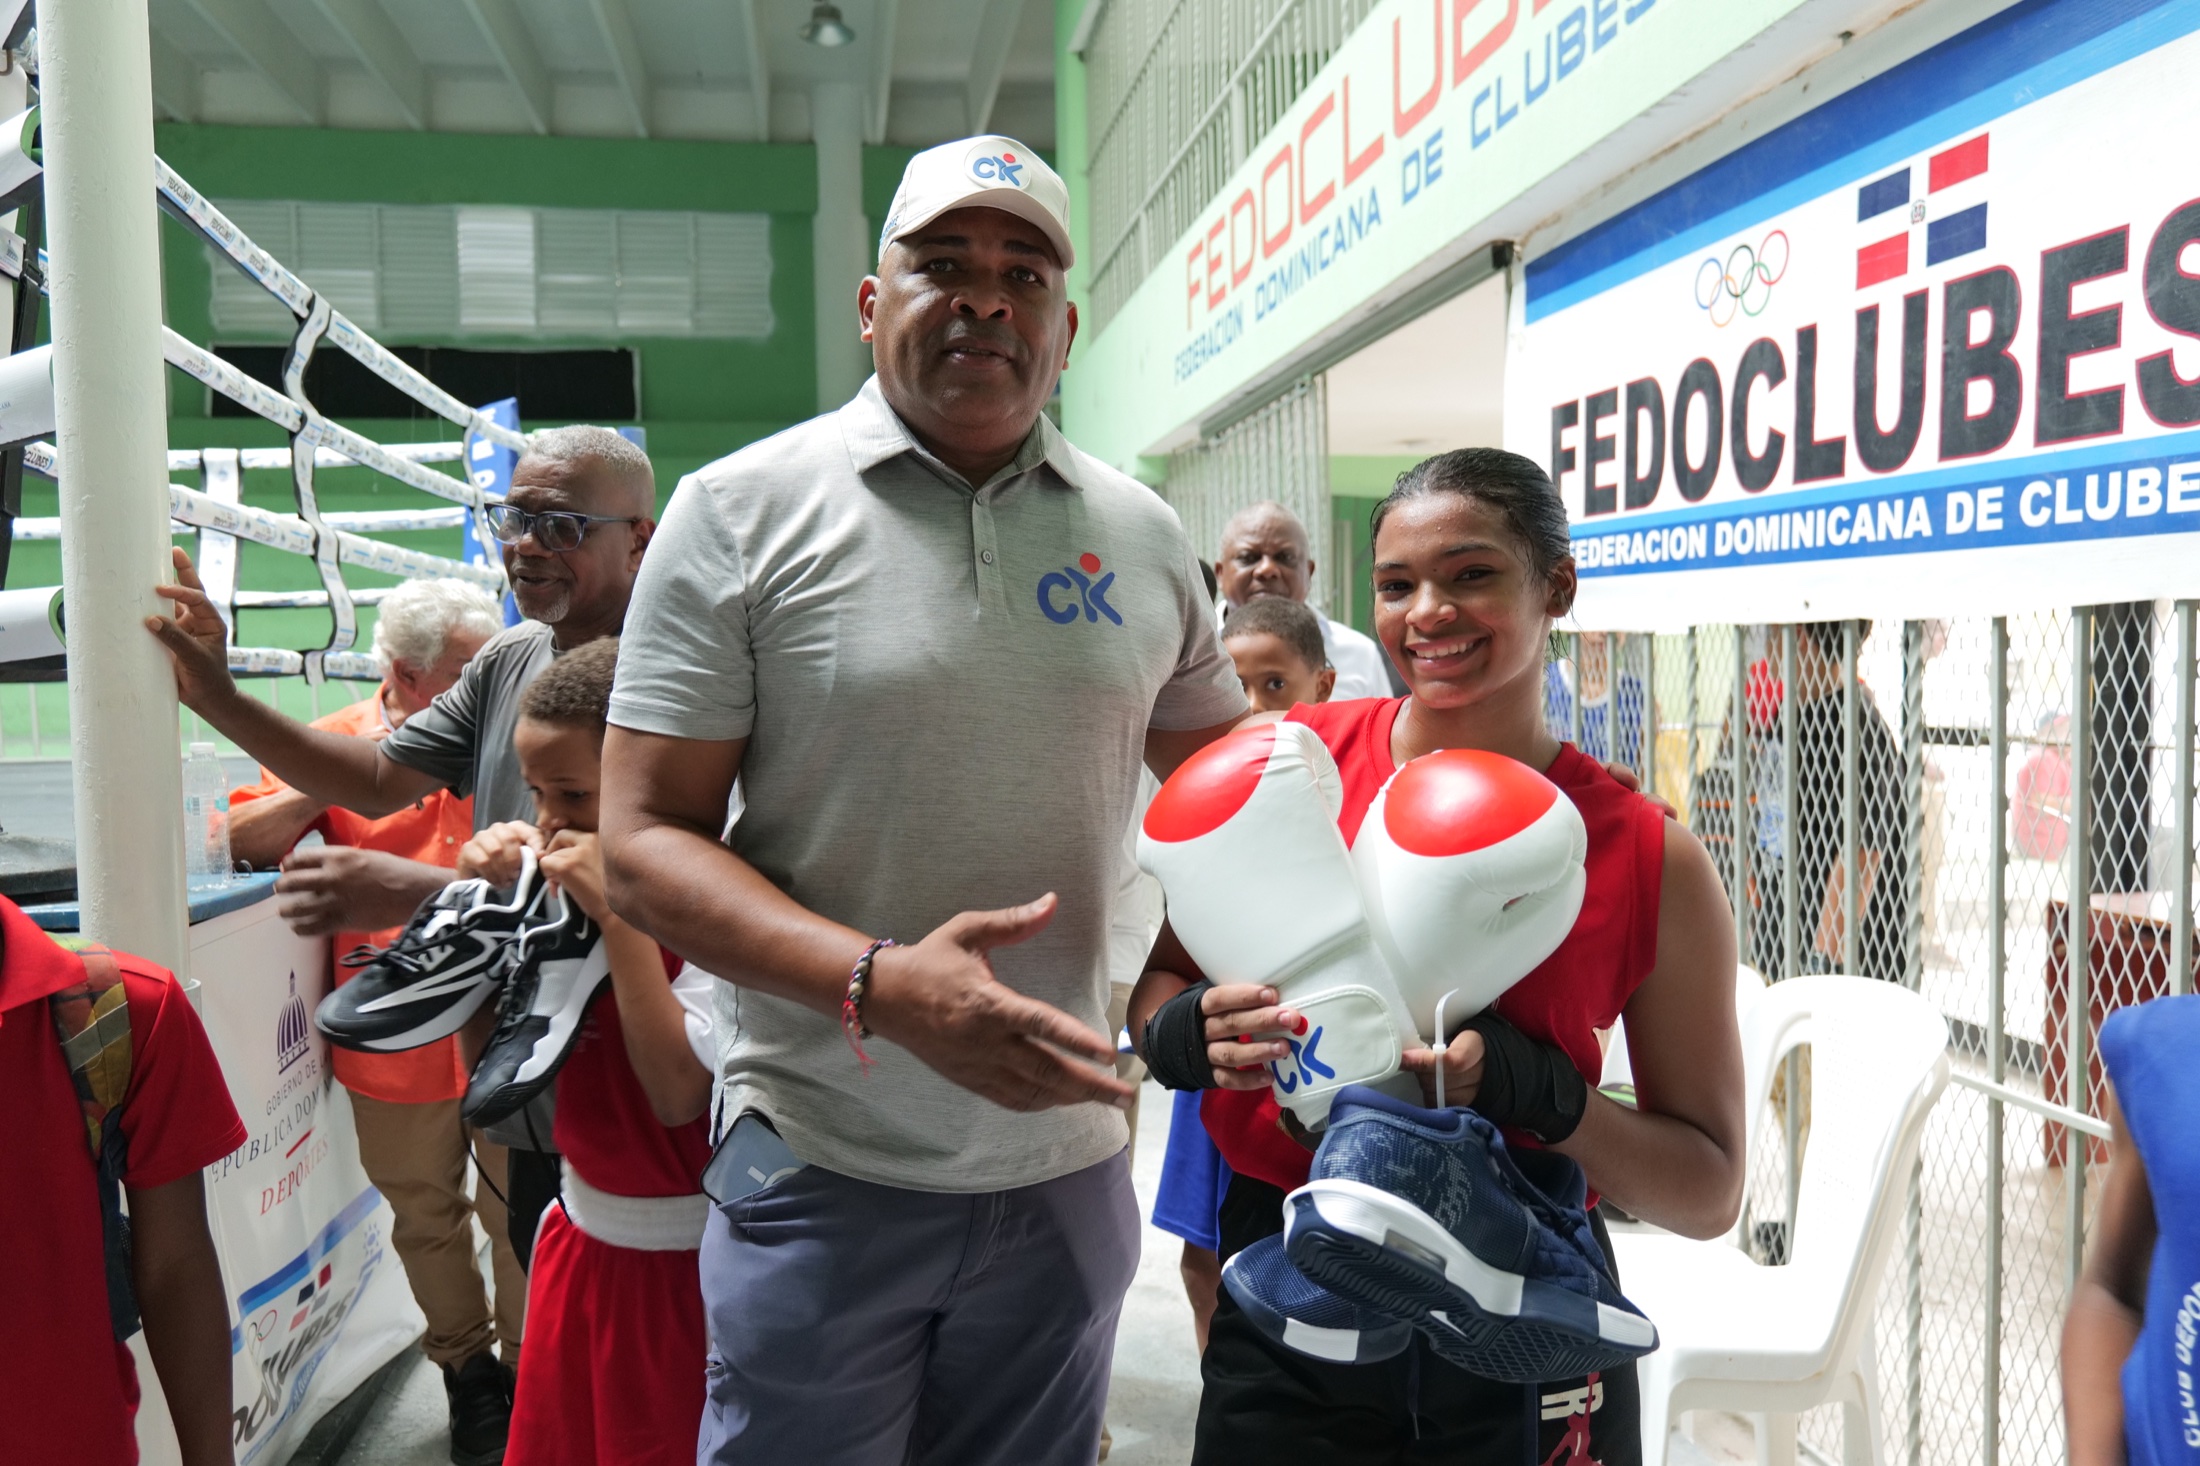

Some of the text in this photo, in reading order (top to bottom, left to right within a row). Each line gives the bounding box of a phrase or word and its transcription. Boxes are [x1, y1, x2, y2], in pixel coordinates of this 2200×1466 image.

[1174, 299, 1244, 387] FEDERACION
[1254, 185, 1382, 322] DOMINICANA
[1402, 127, 1444, 206] DE
[1551, 196, 2200, 518] FEDOCLUBES
[1714, 496, 1933, 557] DOMINICANA
[1946, 486, 2004, 535] DE
[266, 1070, 303, 1116] GOBIERNO
[306, 1058, 317, 1079] DE
[260, 1132, 329, 1216] DEPORTES
